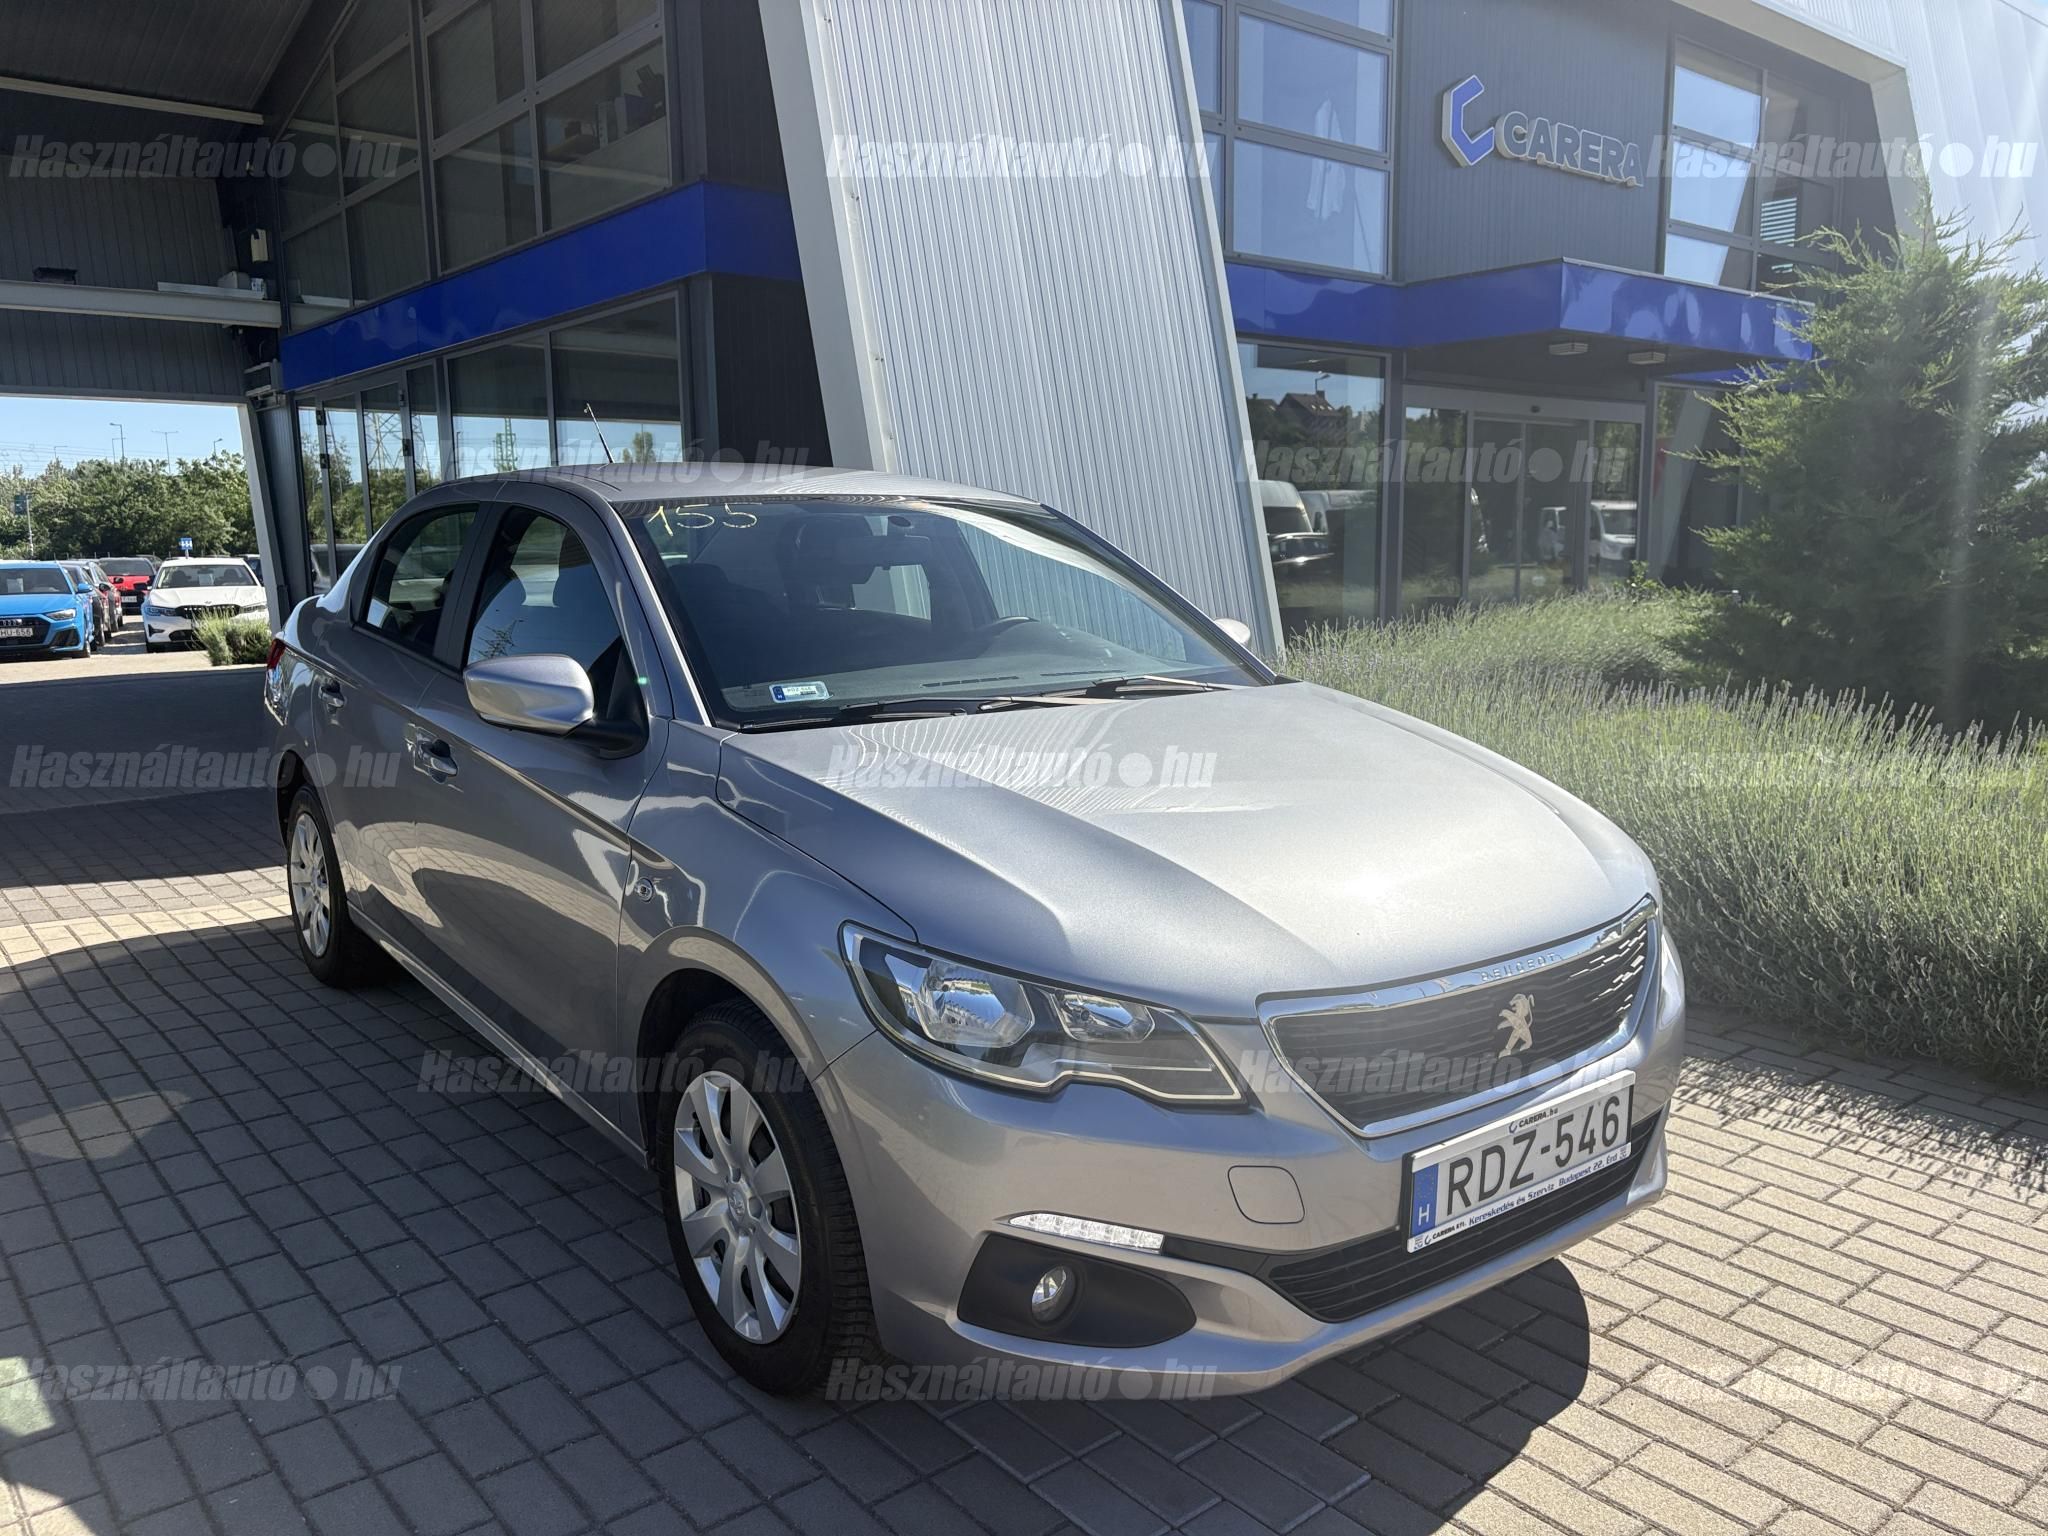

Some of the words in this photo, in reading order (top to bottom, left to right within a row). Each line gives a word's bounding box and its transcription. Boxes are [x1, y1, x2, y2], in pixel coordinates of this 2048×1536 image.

[1496, 111, 1645, 187] CARERA
[648, 502, 762, 537] 155
[1481, 952, 1555, 981] PEUGEOT
[1447, 1095, 1620, 1216] RDZ-546
[1469, 1201, 1514, 1225] Kereskedés
[1528, 1182, 1555, 1200] Szerviz
[1559, 1166, 1592, 1187] Budapest
